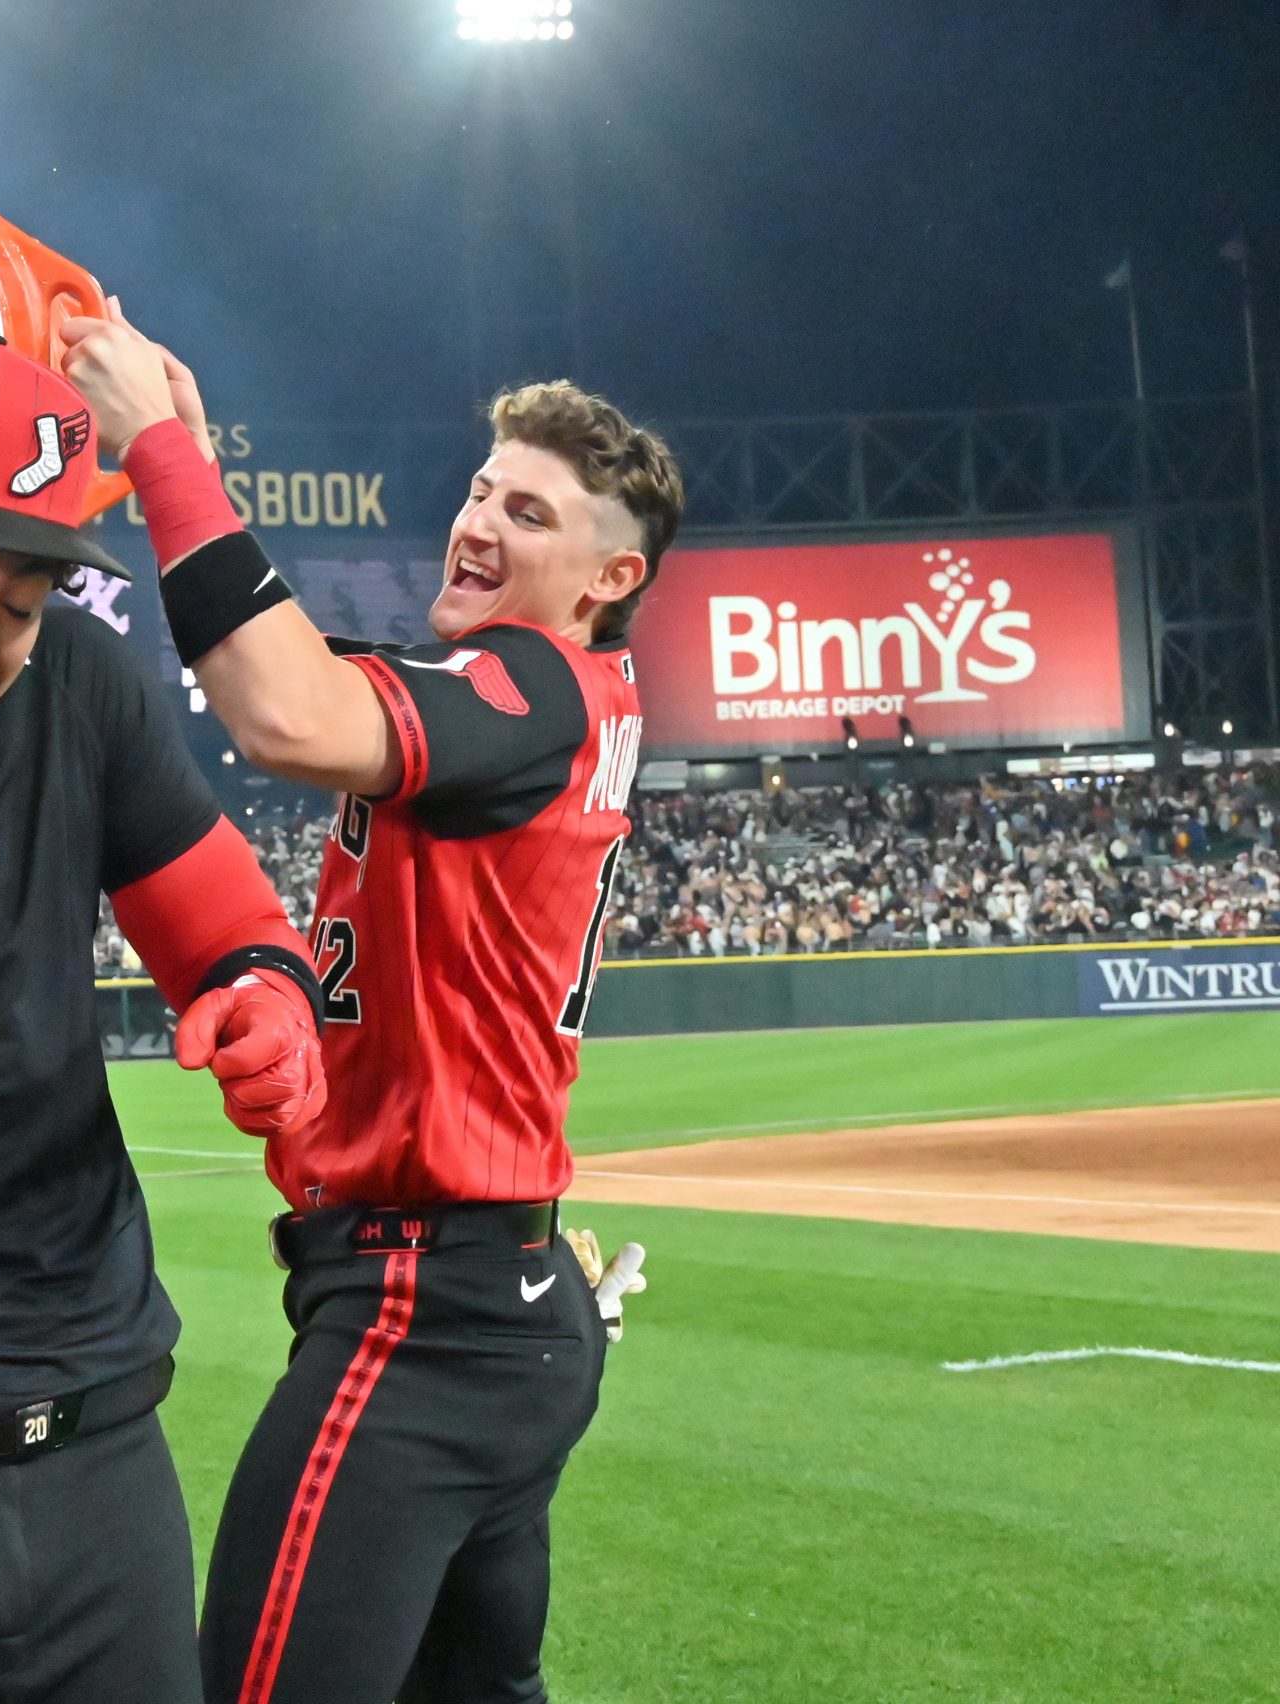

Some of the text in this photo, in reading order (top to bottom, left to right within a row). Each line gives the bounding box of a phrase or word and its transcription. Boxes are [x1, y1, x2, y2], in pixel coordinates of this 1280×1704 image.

[715, 694, 905, 721] BEVERAGE DEPOT
[555, 833, 624, 1038] 1
[24, 1414, 48, 1444] 20
